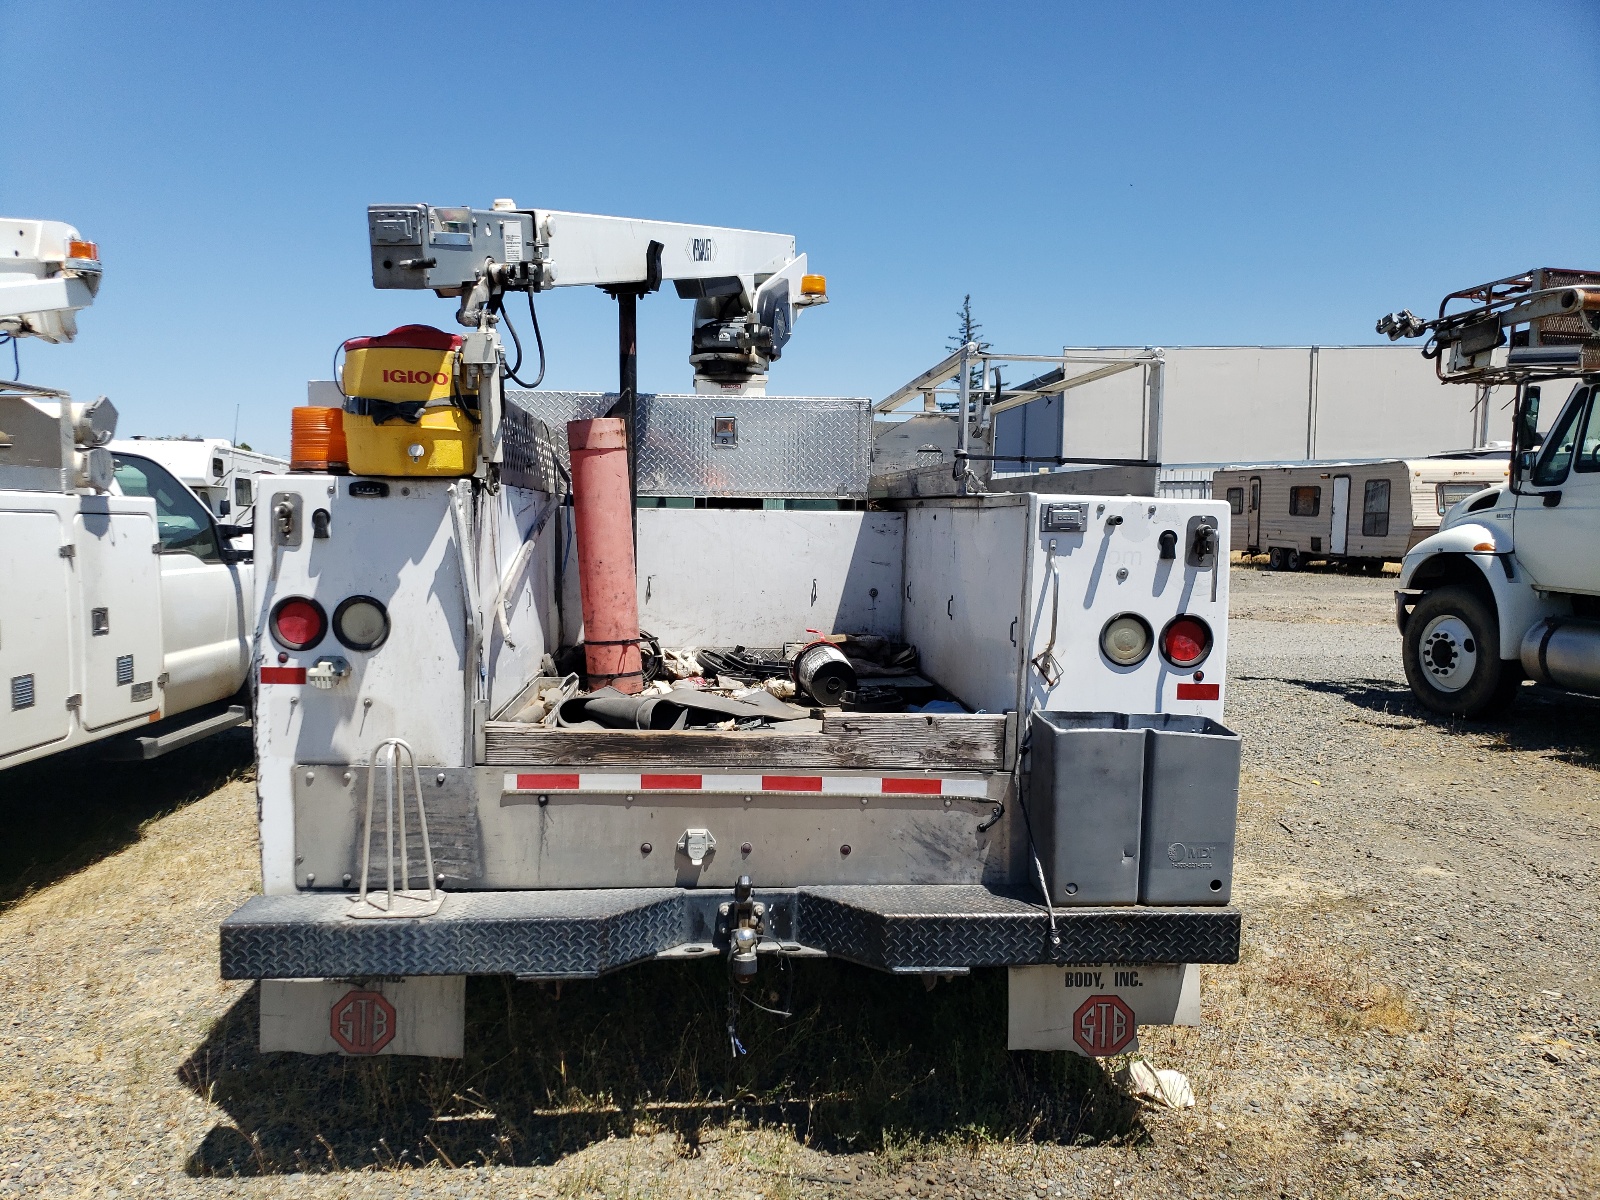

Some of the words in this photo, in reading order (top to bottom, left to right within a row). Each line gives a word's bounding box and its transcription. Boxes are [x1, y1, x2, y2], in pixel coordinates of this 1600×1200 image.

[382, 369, 449, 386] IGLOO
[1064, 971, 1105, 990] BODY,
[1114, 971, 1143, 987] INC.
[338, 999, 388, 1047] STB
[1080, 1003, 1128, 1049] STB
